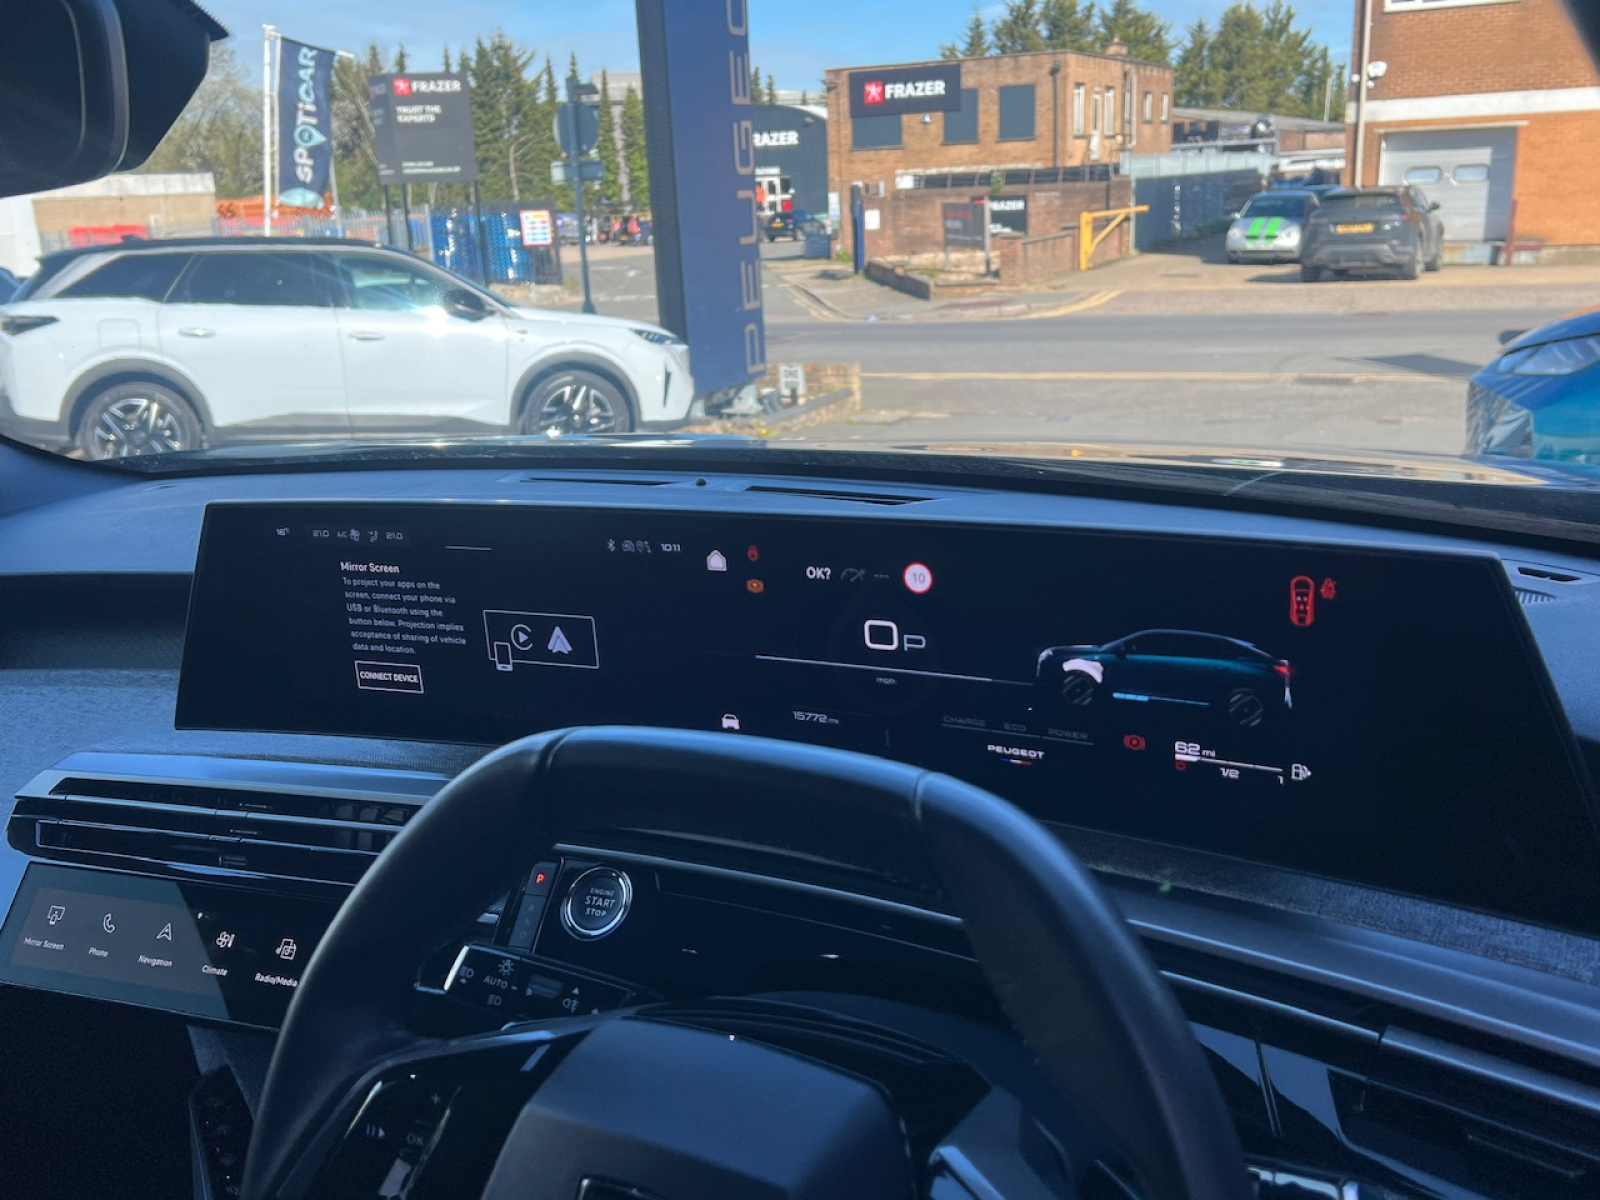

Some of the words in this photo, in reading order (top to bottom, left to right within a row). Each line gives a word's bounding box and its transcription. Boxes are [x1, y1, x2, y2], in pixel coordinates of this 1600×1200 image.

[411, 79, 462, 93] FRAZER
[884, 80, 946, 99] FRAZER
[340, 561, 368, 572] Mirror
[369, 562, 400, 573] Screen
[805, 565, 832, 580] OK?
[342, 577, 352, 586] To
[353, 578, 379, 588] project
[380, 580, 396, 589] your
[397, 581, 415, 590] apps
[416, 582, 426, 590] on
[427, 581, 441, 590] the
[911, 573, 926, 584] 10
[344, 591, 371, 600] screen,
[371, 592, 401, 601] connect
[419, 594, 443, 604] phone
[444, 595, 456, 604] via
[346, 603, 363, 612] USB
[363, 604, 372, 613] or
[373, 603, 408, 615] Bluetooth
[409, 607, 430, 618] using
[430, 607, 443, 617] the
[348, 616, 373, 626] button
[398, 619, 436, 630] Projection
[437, 622, 464, 632] implies
[350, 630, 392, 640] acceptance
[392, 632, 401, 640] of
[401, 632, 430, 644] sharing
[429, 634, 439, 643] of
[439, 636, 466, 645] vehicle
[863, 619, 899, 651] 0
[903, 634, 926, 651] P
[352, 641, 369, 651] data
[369, 642, 384, 652] and
[359, 670, 393, 682] CONNECT
[393, 672, 419, 684] DEVICE
[792, 710, 828, 724] 15772
[943, 715, 986, 727] CHARGE
[1003, 722, 1027, 732] ECO
[1047, 728, 1088, 740] POWER
[986, 744, 1045, 759] PEUGEOT
[1174, 741, 1201, 756] 62
[1201, 749, 1216, 758] mi
[535, 873, 546, 884] P
[589, 887, 616, 898] ENGINE
[584, 895, 617, 909] START
[585, 907, 608, 917] STOP
[23, 937, 42, 948] Mirror
[42, 939, 65, 951] Screen
[88, 947, 109, 958] Phone
[137, 954, 173, 968] Navigation
[201, 964, 228, 977] Climate
[254, 972, 299, 988] Radio/Media
[483, 974, 509, 990] AUTO
